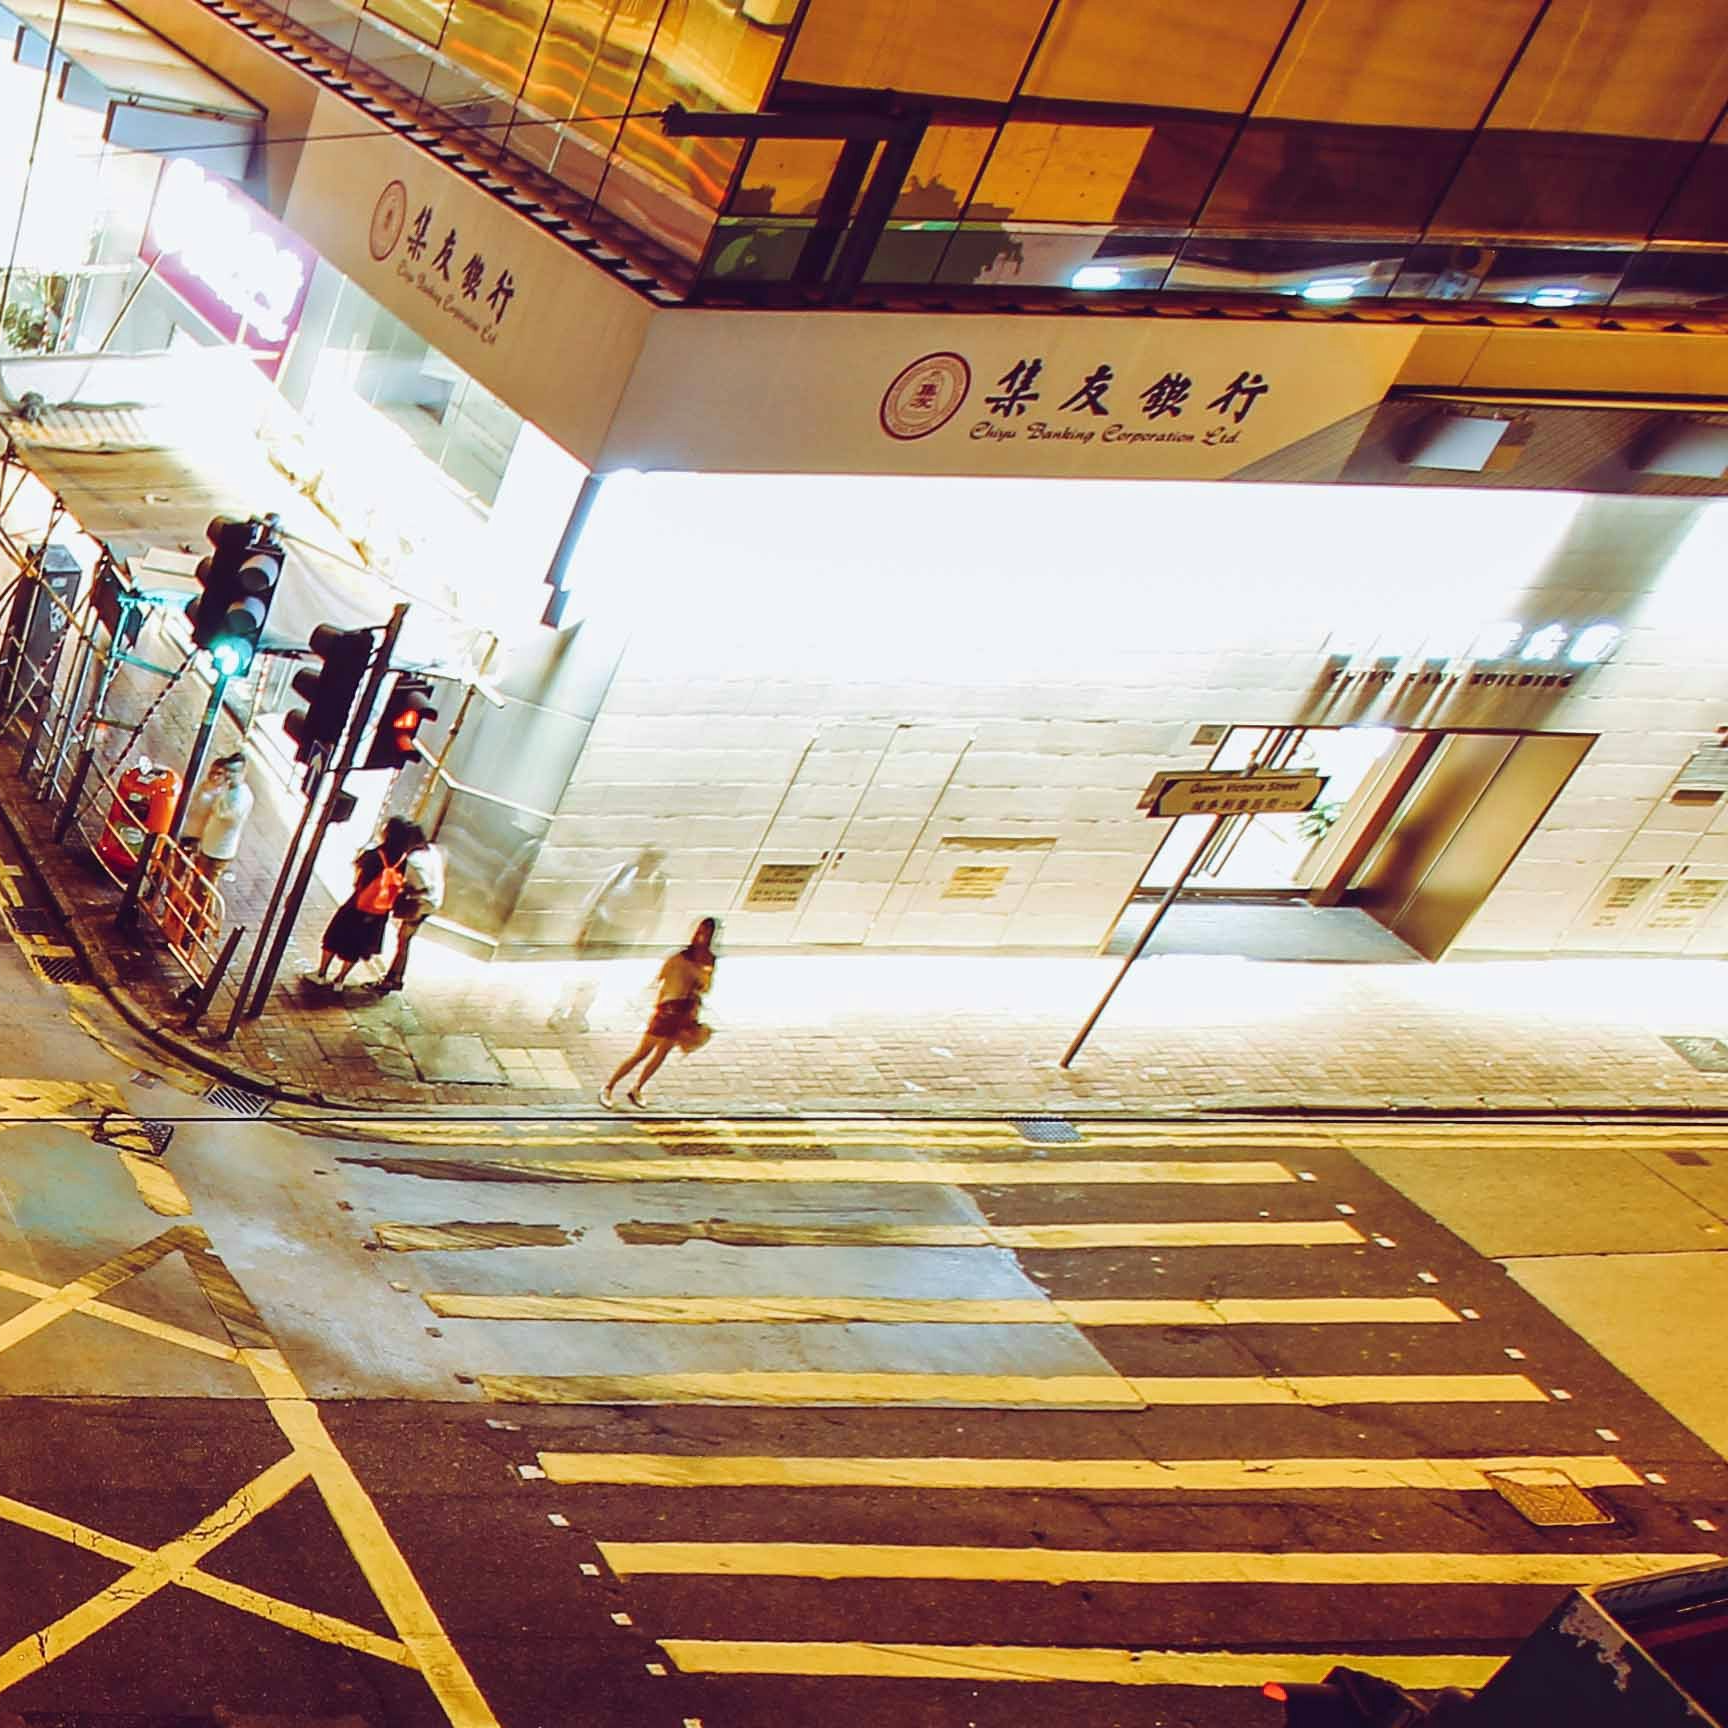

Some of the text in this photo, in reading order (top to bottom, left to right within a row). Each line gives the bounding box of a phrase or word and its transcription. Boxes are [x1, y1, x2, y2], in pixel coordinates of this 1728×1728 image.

[407, 204, 516, 324] 集友銀行
[984, 358, 1270, 424] 集友銀行
[968, 421, 1241, 447] Chiyu Banking Corporation Ltd.
[1189, 780, 1302, 794] Queen Victoria Street
